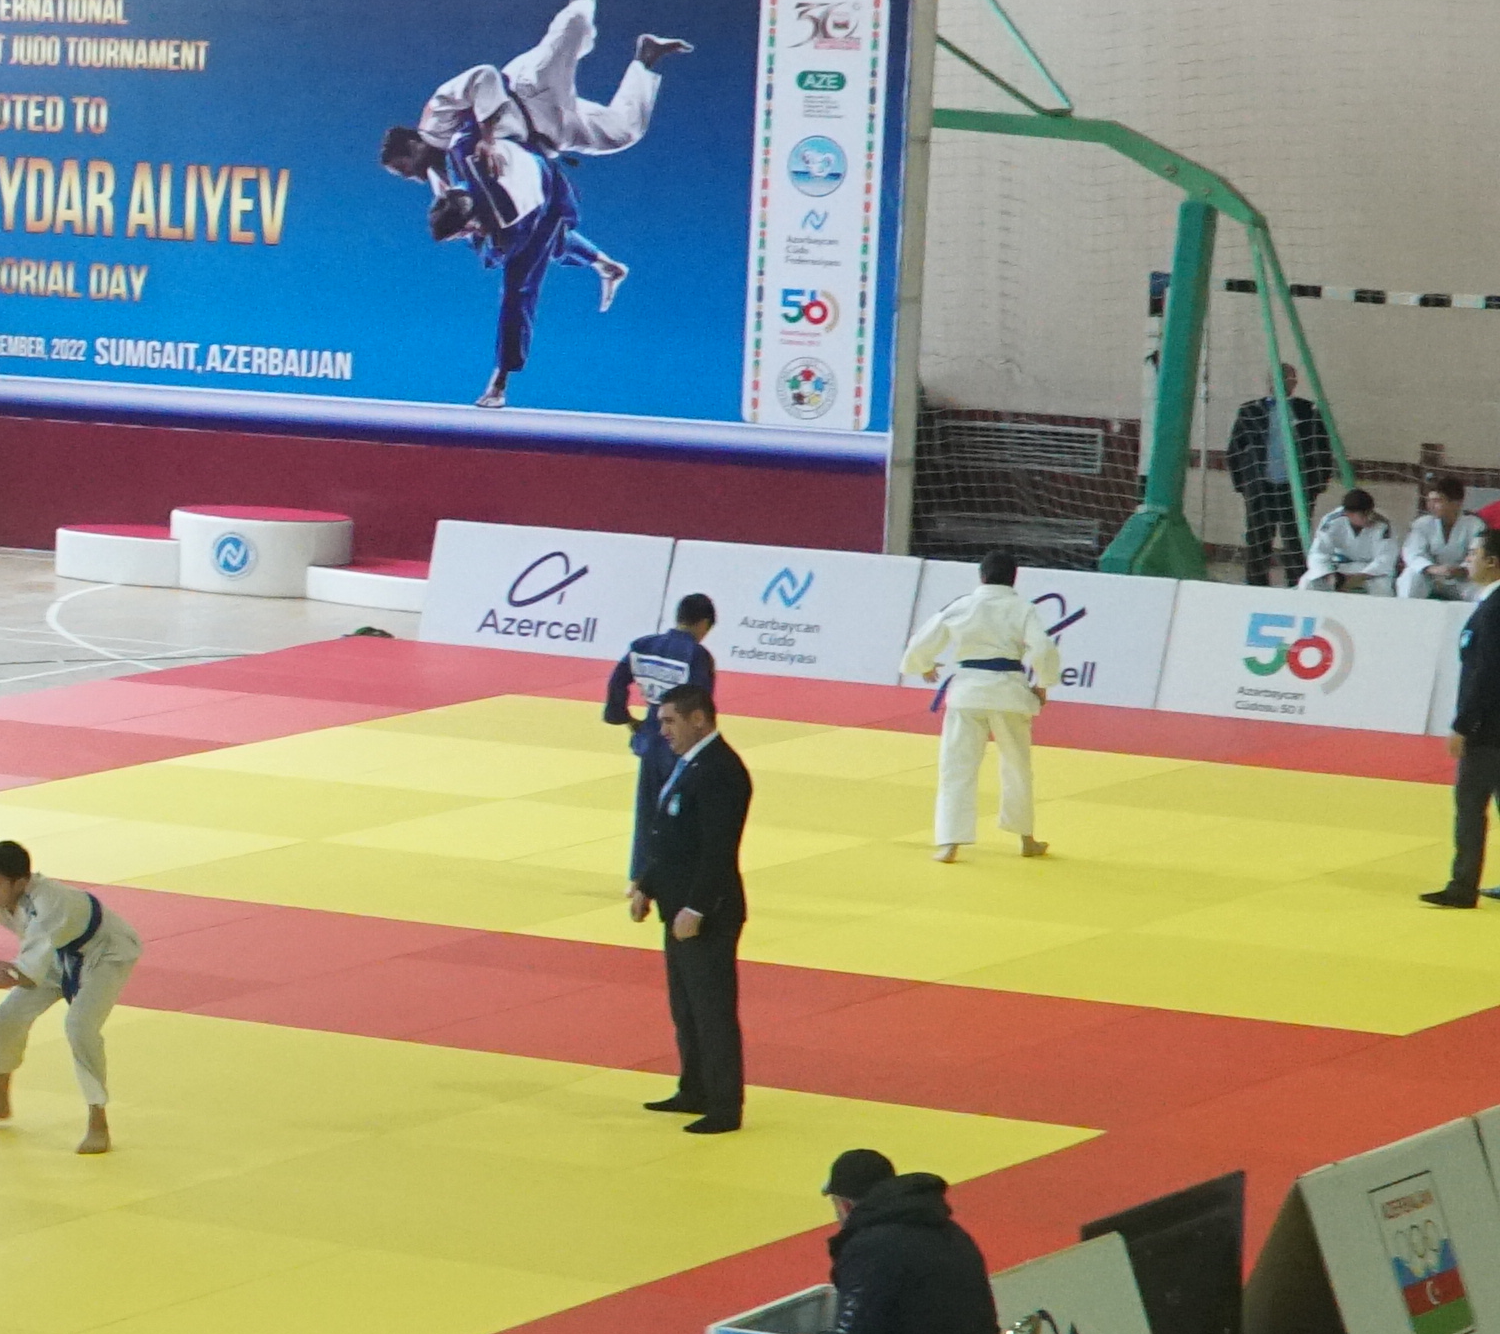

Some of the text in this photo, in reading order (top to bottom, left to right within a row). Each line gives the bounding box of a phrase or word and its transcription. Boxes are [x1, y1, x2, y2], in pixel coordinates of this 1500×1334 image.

[10, 35, 61, 66] JUDO
[65, 37, 210, 71] TOURNAMENT
[803, 73, 840, 88] AZE
[72, 96, 108, 134] TO
[126, 161, 290, 245] ALIYEV
[89, 262, 148, 302] DAY
[51, 338, 87, 361] 2022
[94, 337, 202, 373] SUMGAIT,
[206, 344, 352, 380] AZERBAIJAN
[476, 608, 598, 643] Azercell
[1242, 612, 1334, 681] 50
